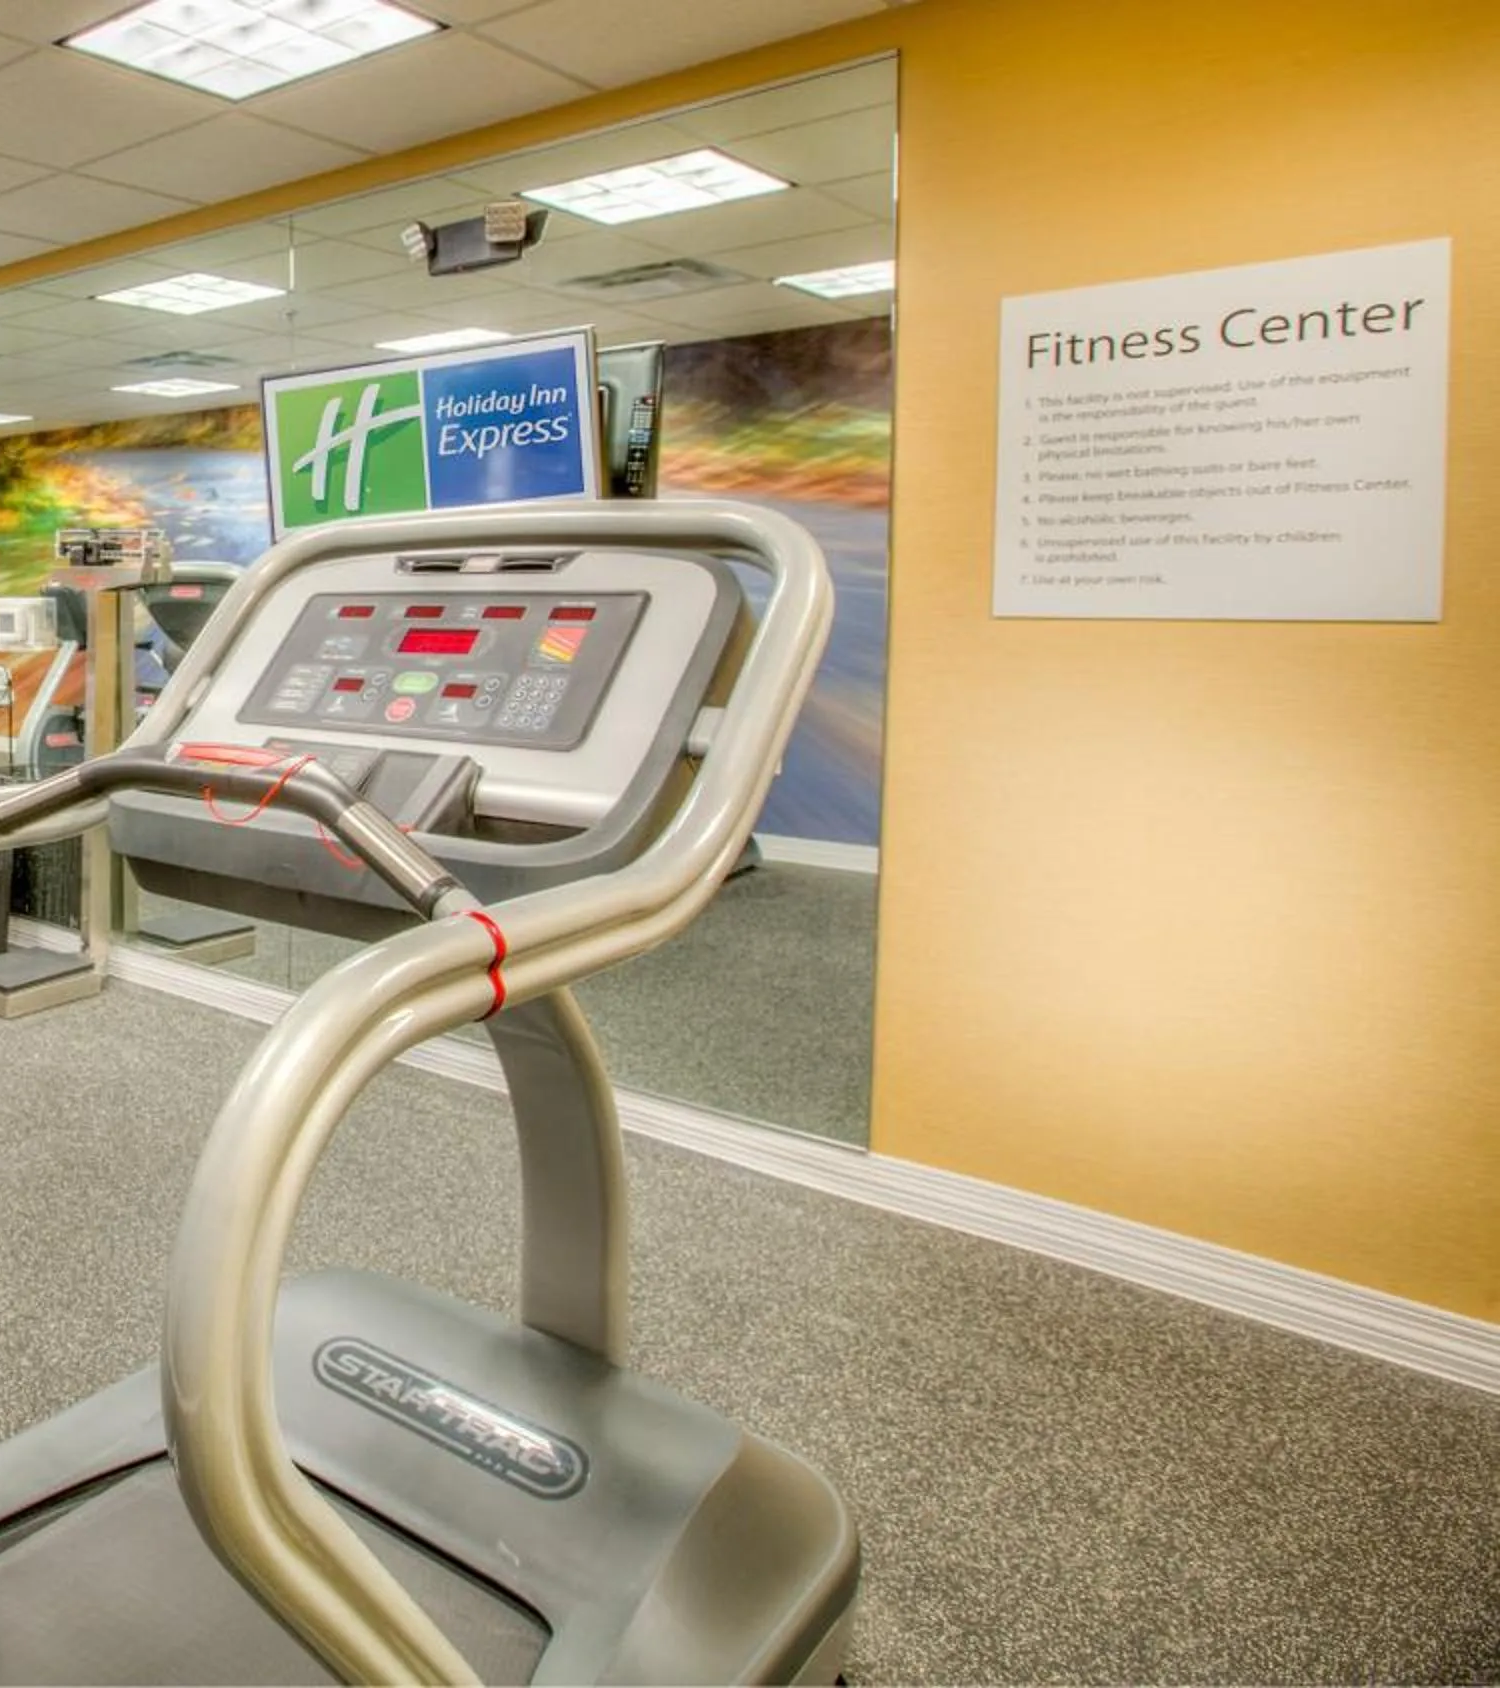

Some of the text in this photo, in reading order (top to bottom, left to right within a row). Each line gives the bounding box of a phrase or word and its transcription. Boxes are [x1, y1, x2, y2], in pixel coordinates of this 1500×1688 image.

[1028, 297, 1426, 369] Fitness Center
[1067, 392, 1109, 405] facility
[1113, 391, 1123, 401] is
[1126, 389, 1150, 400] not
[1238, 379, 1266, 391] Use
[1269, 375, 1285, 388] of
[1288, 374, 1314, 385] the
[1318, 366, 1411, 384] equipment
[435, 383, 567, 421] Holiday Inn
[1052, 410, 1073, 422] the
[1076, 403, 1166, 420] responsibility
[1169, 401, 1184, 413] of
[1188, 399, 1210, 411] the
[437, 414, 570, 459] Express
[1039, 432, 1077, 445] Guest
[1080, 430, 1090, 442] is
[1093, 427, 1171, 443] responsible
[1174, 425, 1193, 435] for
[1197, 420, 1263, 435] knowing
[1324, 415, 1360, 426] own
[1038, 446, 1090, 462] physical
[1085, 471, 1103, 481] no
[1105, 468, 1132, 479] wet
[1134, 465, 1189, 479] bathing
[1192, 463, 1225, 475] suits
[1228, 463, 1244, 473] or
[1247, 459, 1281, 472] bare
[1038, 492, 1079, 504] Please
[1081, 490, 1114, 505] keep
[1117, 487, 1186, 502] breakable
[1189, 485, 1242, 501] objects
[1246, 484, 1271, 495] out
[1275, 482, 1290, 494] of
[1294, 481, 1350, 493] Fitness
[1058, 513, 1116, 526] alcoholic
[1037, 534, 1125, 550] Unsupervised
[1129, 536, 1150, 547] use
[1154, 533, 1170, 545] of
[1173, 533, 1199, 545] this
[1202, 531, 1249, 546] facility
[1252, 531, 1272, 545] by
[1276, 530, 1343, 544] children
[1032, 574, 1054, 585] Use
[1058, 574, 1071, 585] at
[1074, 574, 1103, 588] your
[1106, 574, 1137, 585] own
